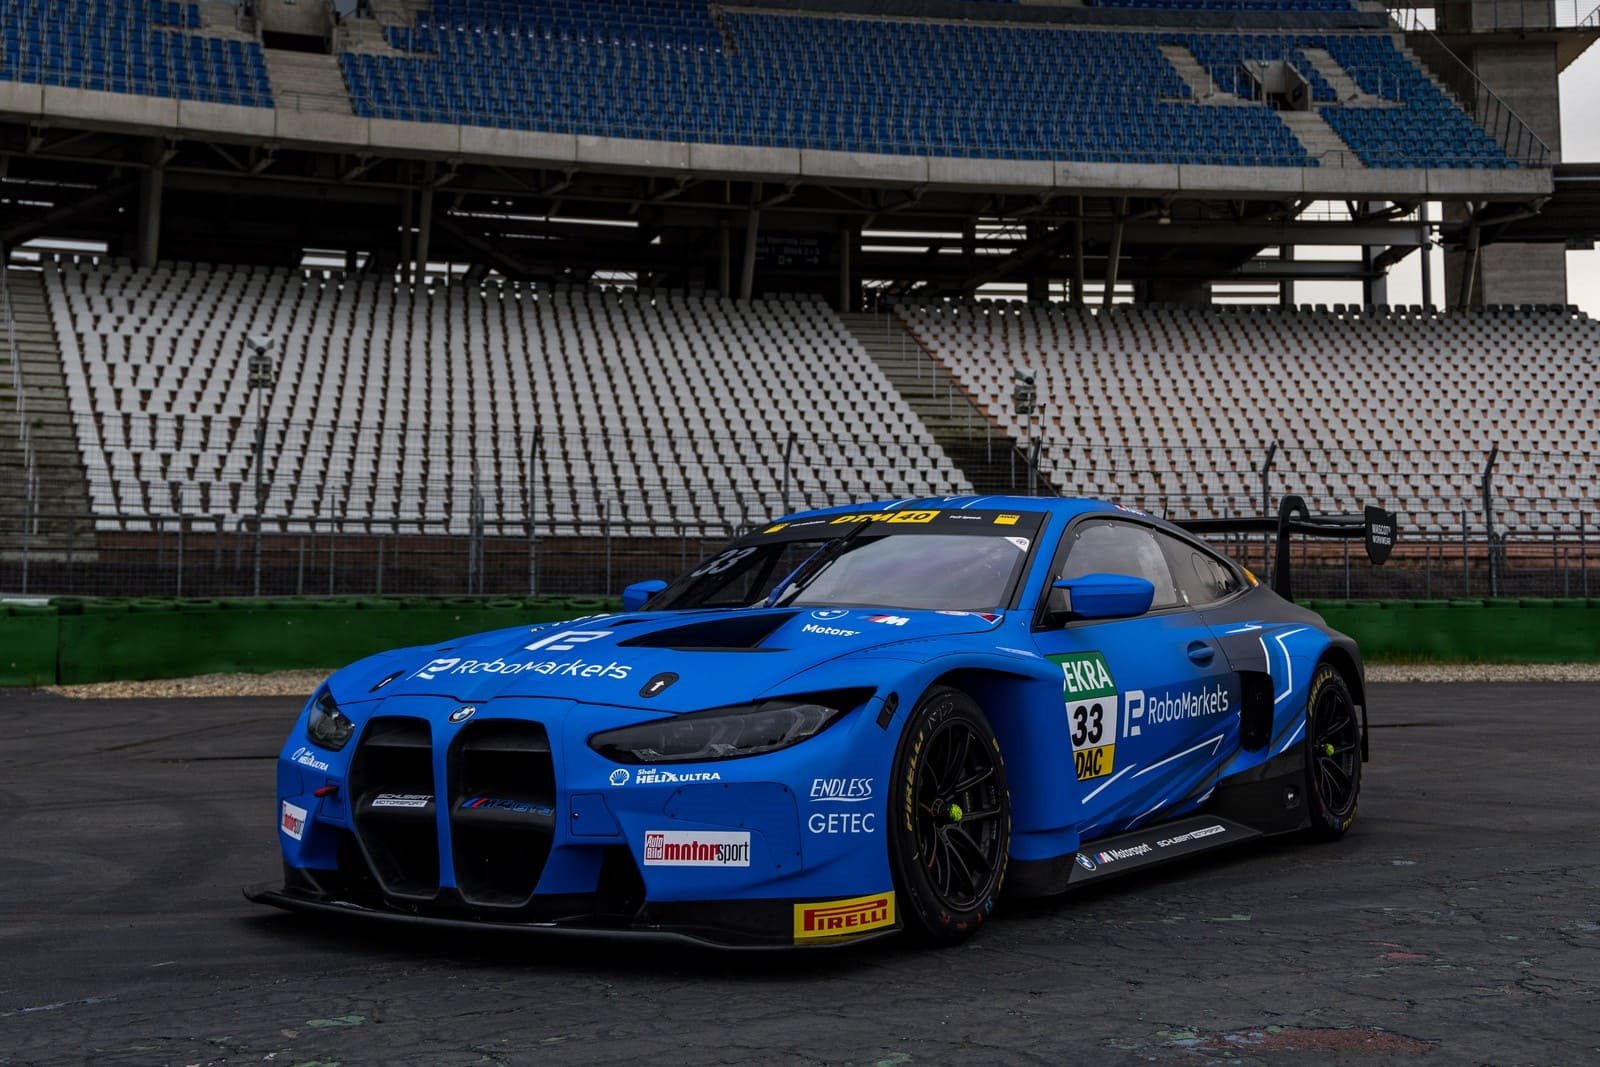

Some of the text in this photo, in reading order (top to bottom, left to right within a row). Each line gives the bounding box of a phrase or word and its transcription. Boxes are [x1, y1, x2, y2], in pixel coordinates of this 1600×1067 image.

[830, 511, 928, 525] DTM 40
[690, 546, 757, 577] 33
[454, 658, 633, 680] RoboMarkets
[1063, 658, 1114, 693] EKRA
[1148, 683, 1229, 725] RoboMarkets
[1071, 702, 1104, 747] 33
[635, 771, 721, 784] HELIX ULTRA
[810, 778, 873, 798] ENDLESS
[904, 730, 924, 832] PIRELLI
[808, 813, 875, 834] GETEC
[803, 898, 889, 932] PIRELLI
